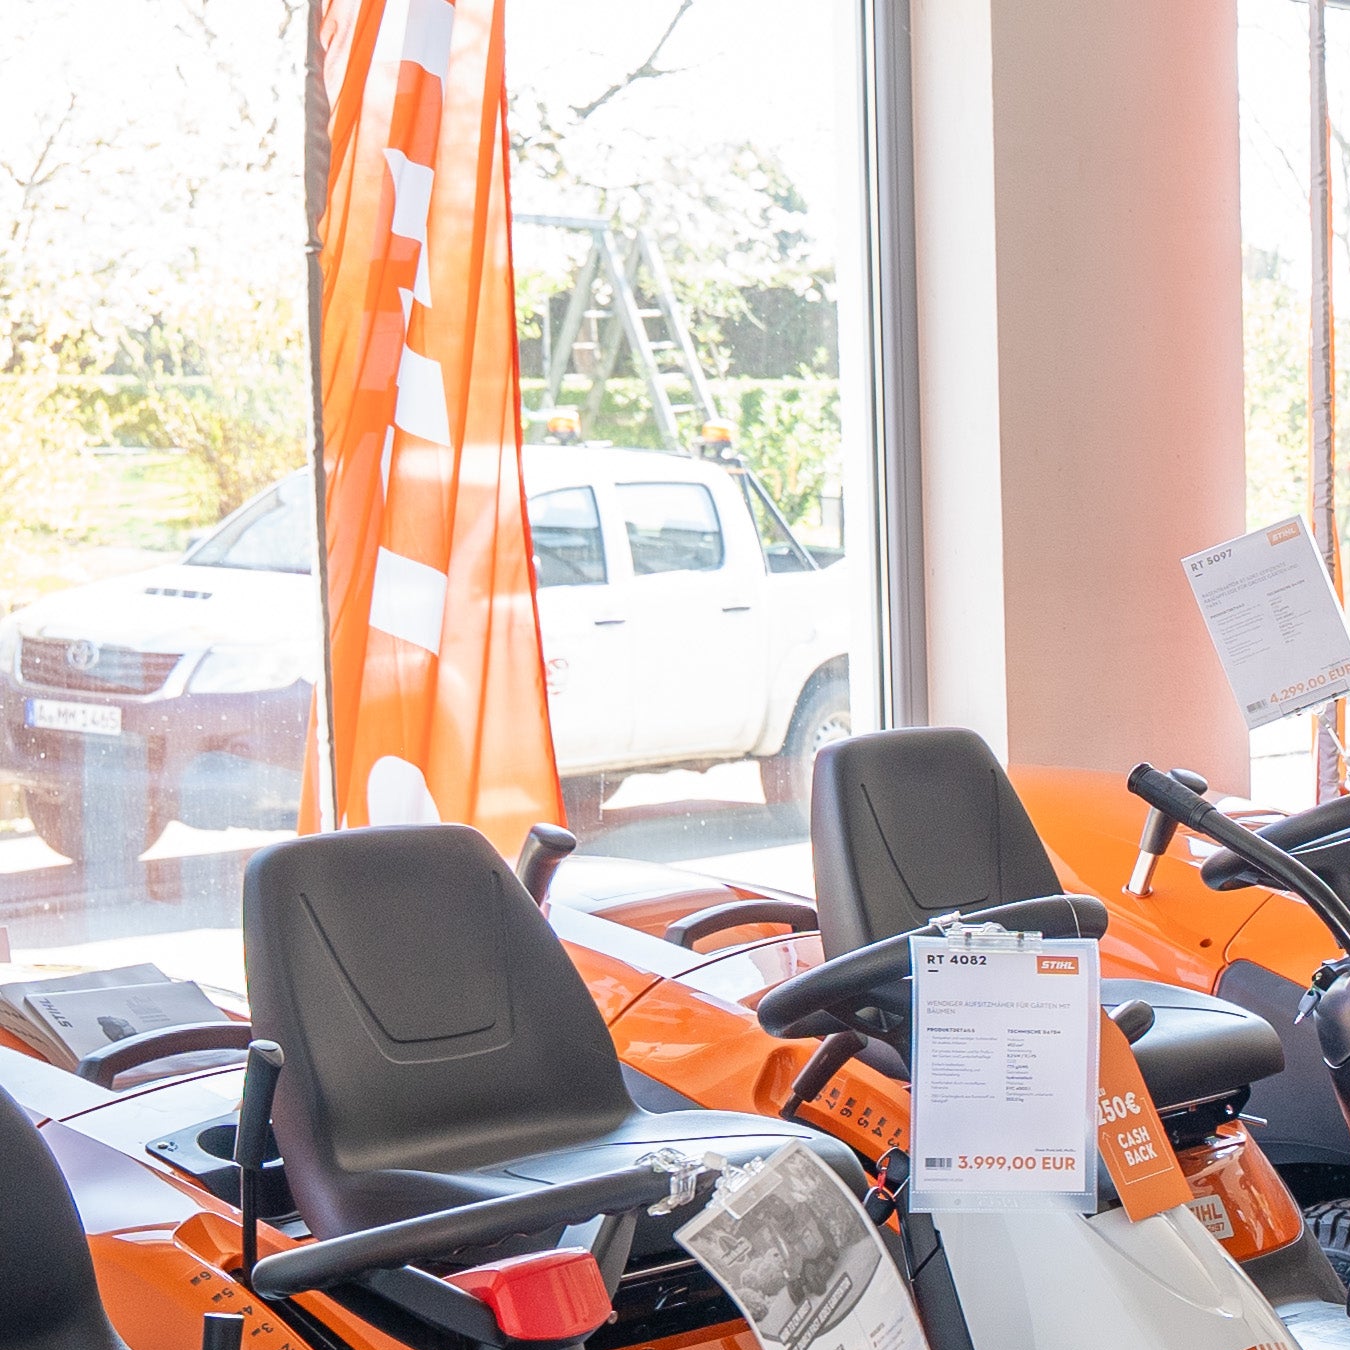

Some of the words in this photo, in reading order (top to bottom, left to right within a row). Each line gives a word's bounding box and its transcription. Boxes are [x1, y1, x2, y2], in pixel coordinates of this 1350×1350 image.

[1271, 527, 1296, 541] STIHL
[1191, 559, 1205, 573] RT
[1207, 549, 1233, 567] 5097
[927, 954, 945, 965] RT
[949, 955, 987, 966] 4082
[1041, 960, 1076, 970] STIHL
[39, 998, 74, 1029] STIHL
[926, 1000, 963, 1008] WENDIGER
[964, 1000, 1015, 1010] AUFSITZMÄHER
[1016, 1001, 1030, 1010] FÜR
[1030, 1001, 1058, 1010] GÄRTEN
[926, 1006, 956, 1015] BÄUMEN
[825, 1099, 837, 1110] 7
[840, 1107, 853, 1118] 6
[857, 1117, 870, 1129] 5
[871, 1126, 883, 1138] 4
[1117, 1126, 1151, 1149] CASH
[958, 1155, 1037, 1171] 3.999,00
[1041, 1156, 1076, 1171] EUR
[1124, 1142, 1158, 1167] BACK
[200, 1271, 212, 1281] 6
[222, 1287, 235, 1298] 5
[242, 1304, 253, 1316] 4
[261, 1322, 274, 1334] 3
